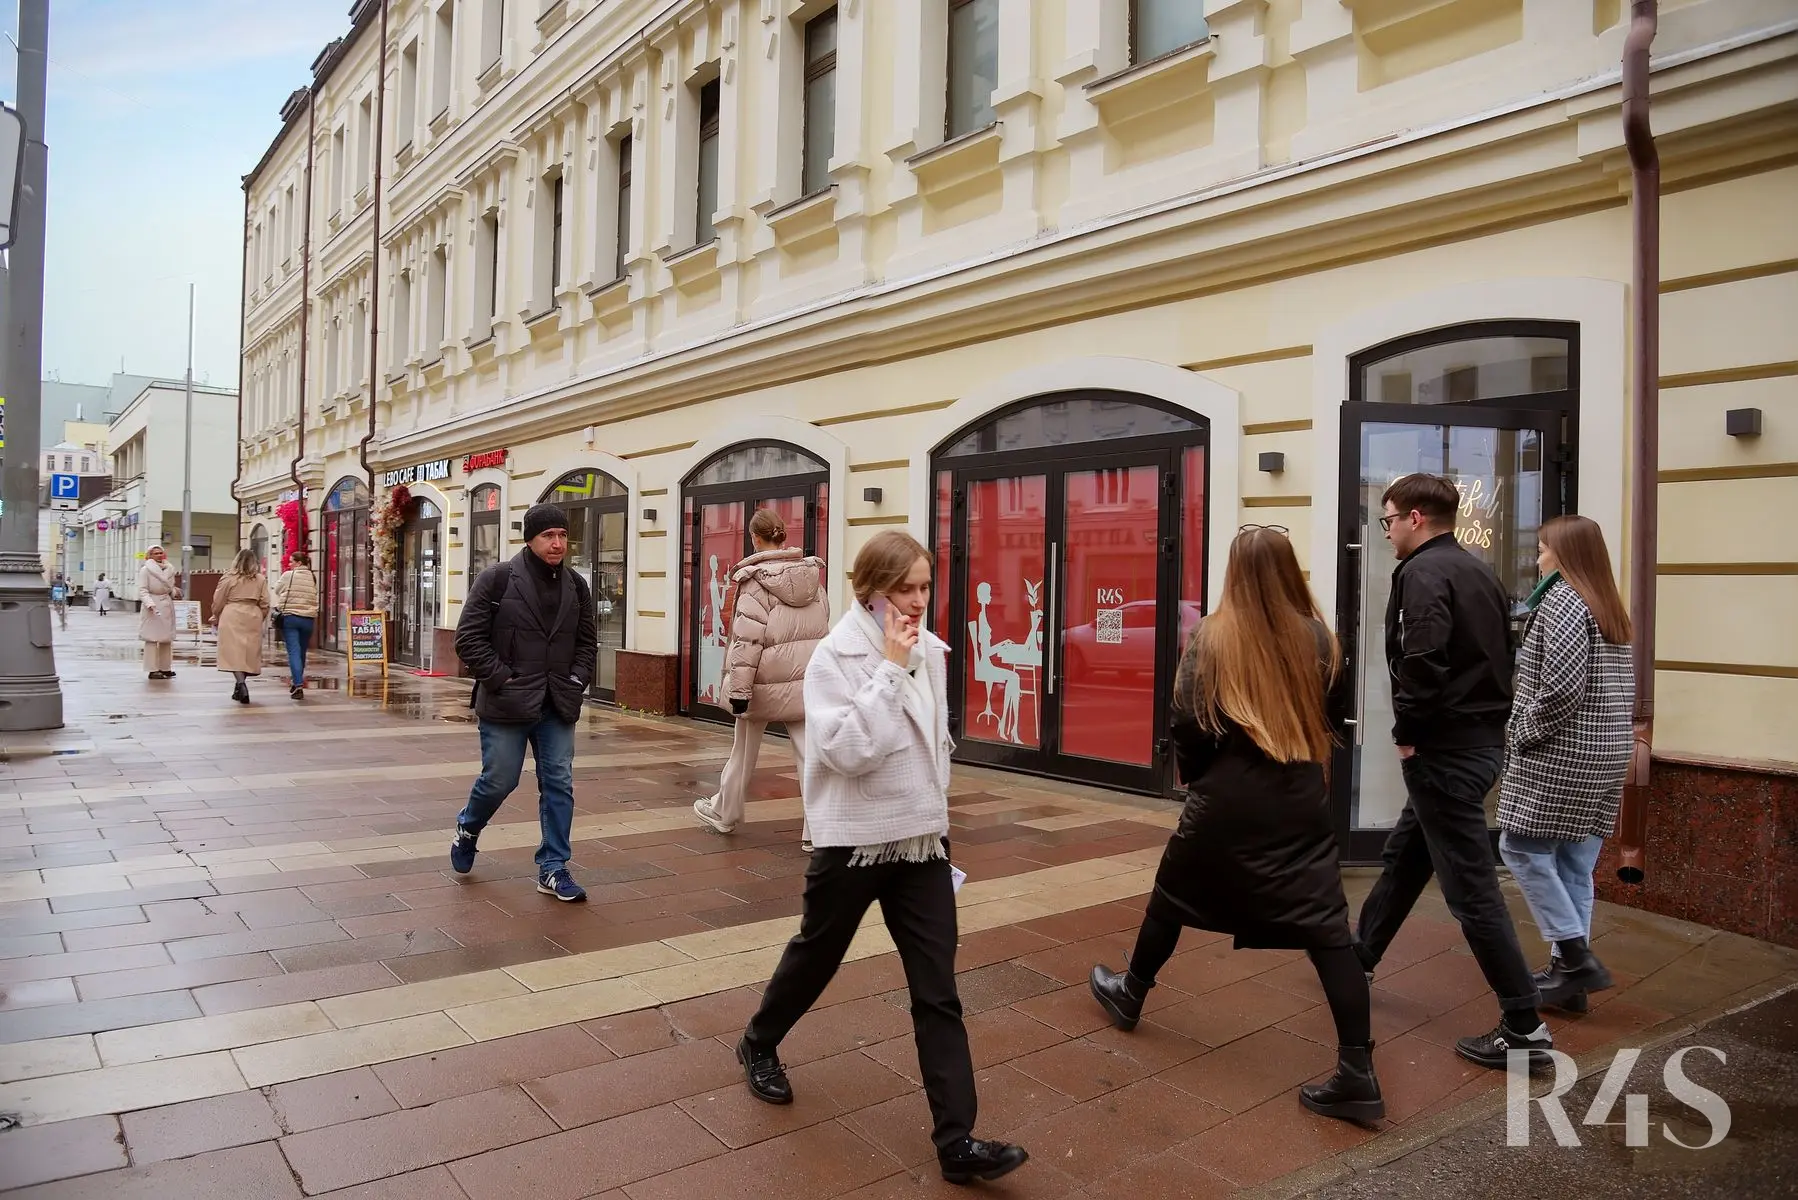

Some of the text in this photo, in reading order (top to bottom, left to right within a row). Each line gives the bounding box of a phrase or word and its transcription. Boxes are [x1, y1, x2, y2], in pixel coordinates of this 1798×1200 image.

[383, 466, 414, 487] LEBO CAFE
[426, 459, 449, 481] ТАБАК
[59, 477, 75, 495] P
[1454, 520, 1492, 549] vors
[1097, 588, 1124, 604] R4S
[352, 626, 382, 634] ТАБАК
